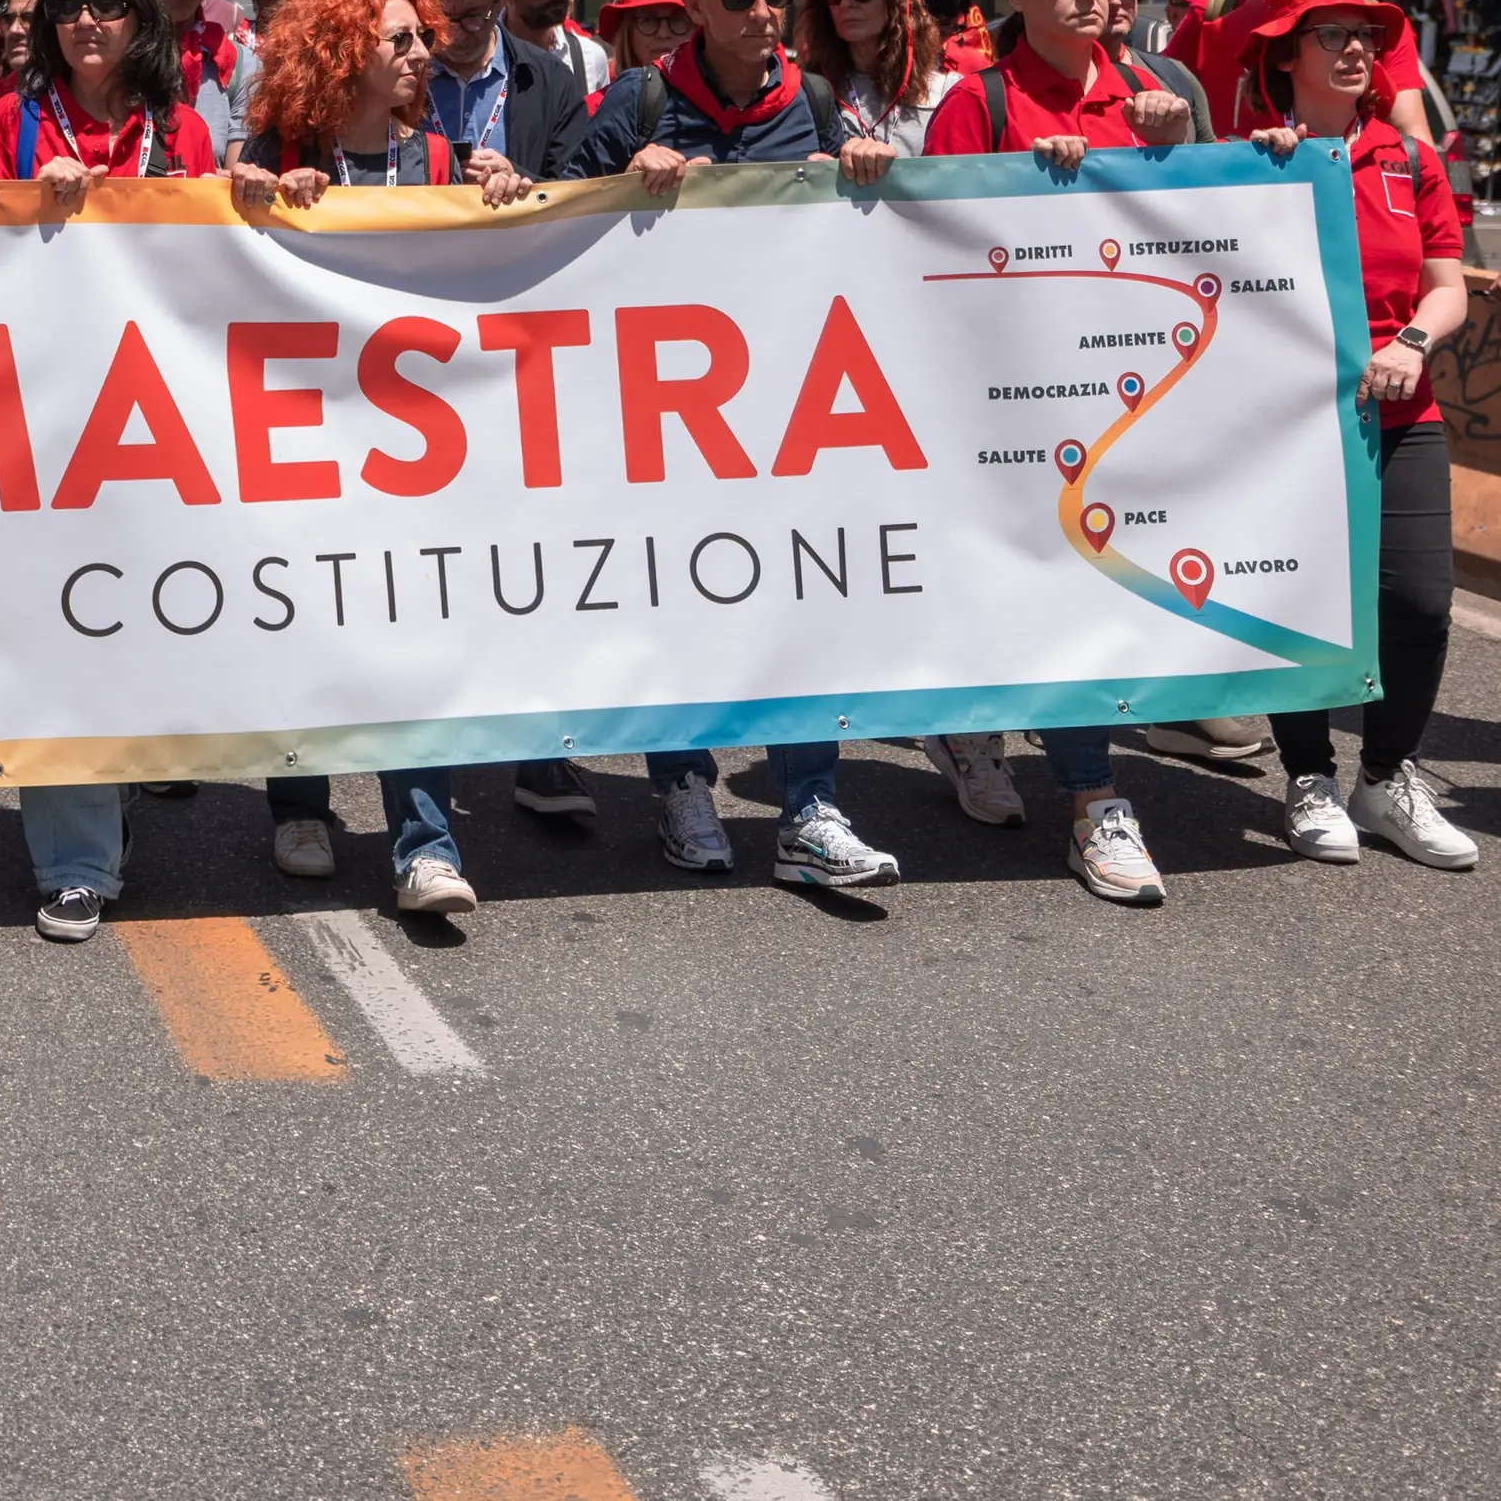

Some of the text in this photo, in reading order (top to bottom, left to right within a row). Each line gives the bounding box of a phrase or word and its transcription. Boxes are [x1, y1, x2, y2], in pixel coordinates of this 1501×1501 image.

[1380, 160, 1410, 175] CGI
[1014, 244, 1073, 261] DIRITTI
[1129, 238, 1239, 256] ISTRUZIONE
[1230, 278, 1295, 294] SALARI
[1079, 331, 1166, 349] AMBIENTE
[988, 381, 1110, 400] DEMOCRAZIA
[978, 449, 1046, 465] SALUTE
[1124, 510, 1167, 526] PACE
[1223, 558, 1299, 575] LAVORO
[61, 522, 923, 638] COSTITUZIONE
